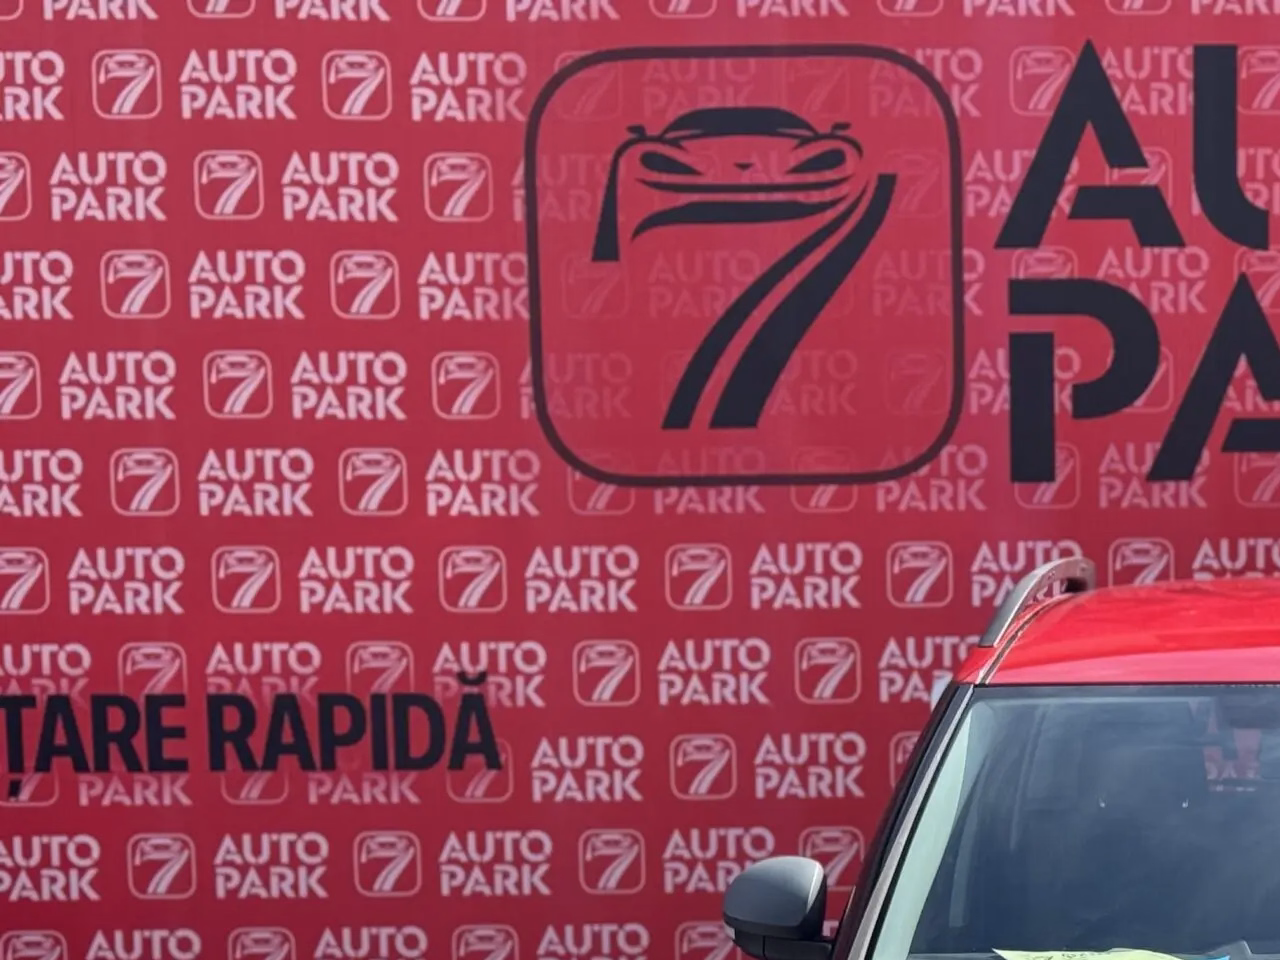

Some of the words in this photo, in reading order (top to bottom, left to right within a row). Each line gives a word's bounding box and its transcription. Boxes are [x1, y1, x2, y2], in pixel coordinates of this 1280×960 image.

[179, 49, 297, 84] AUTO
[410, 52, 526, 86] AUTO
[181, 84, 296, 119] PARK
[412, 87, 525, 121] PARK
[50, 151, 167, 185] AUTO
[282, 152, 399, 187] AUTO
[51, 186, 166, 221] PARK
[283, 186, 398, 222] PARK
[188, 250, 305, 284] AUTO
[417, 252, 527, 285] AUTO
[190, 284, 304, 319] PARK
[419, 286, 529, 320] PARK
[59, 351, 176, 385] AUTO
[291, 351, 407, 385] AUTO
[61, 386, 175, 420] PARK
[292, 385, 406, 420] PARK
[198, 448, 314, 482] AUTO
[425, 449, 539, 482] AUTO
[199, 482, 312, 516] PARK
[425, 482, 535, 516] PARK
[68, 546, 185, 580] AUTO
[298, 546, 414, 579] AUTO
[525, 545, 639, 578] AUTO
[750, 542, 862, 575] AUTO
[69, 581, 184, 614] PARK
[298, 579, 410, 613] PARK
[526, 579, 637, 613] PARK
[751, 576, 860, 609] PARK
[206, 642, 321, 674] AUTO
[433, 641, 547, 674] AUTO
[658, 638, 770, 671] AUTO
[658, 671, 766, 705] PARK
[206, 671, 503, 772] RAPIDĂ
[531, 736, 644, 768] AUTO
[754, 732, 866, 765] AUTO
[79, 772, 192, 806] PARK
[309, 771, 420, 804] PARK
[532, 769, 642, 802] PARK
[756, 766, 864, 798] PARK
[214, 832, 329, 865] AUTO
[439, 830, 552, 863] AUTO
[663, 827, 774, 860] AUTO
[216, 866, 327, 898] PARK
[440, 863, 550, 896] PARK
[86, 929, 201, 960] AUTO
[314, 926, 427, 958] AUTO
[537, 923, 649, 955] AUTO
